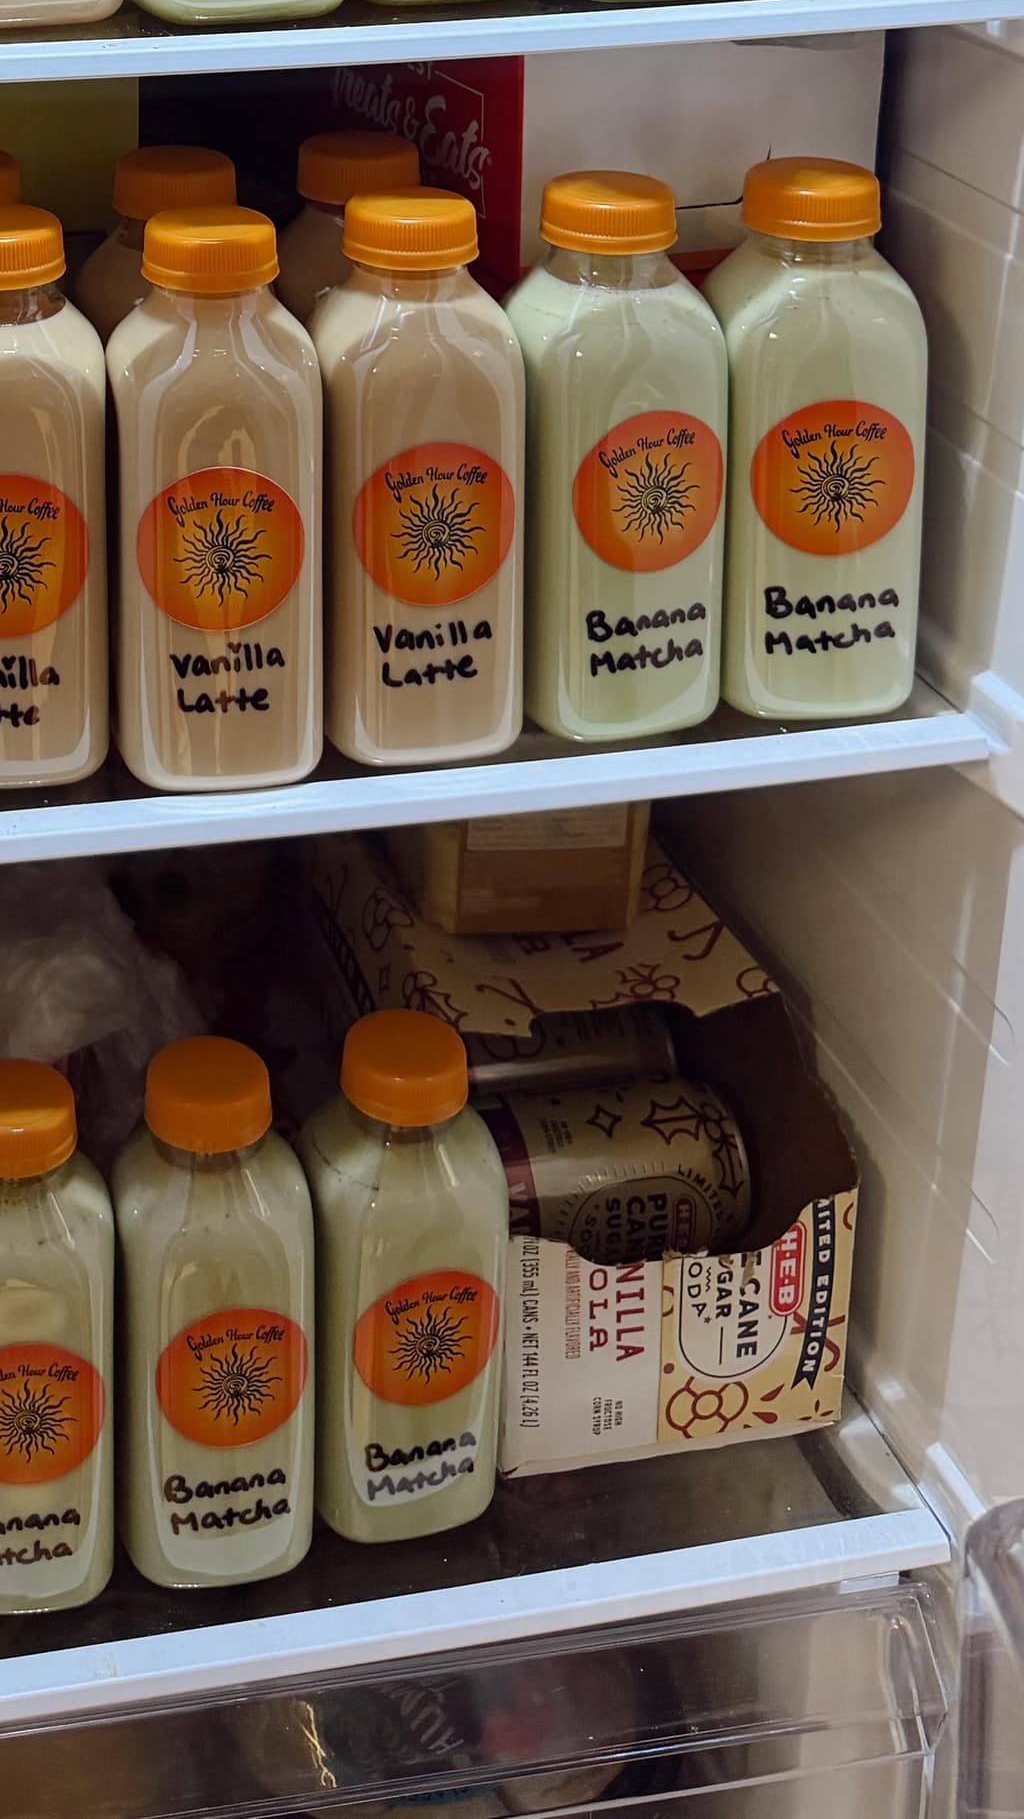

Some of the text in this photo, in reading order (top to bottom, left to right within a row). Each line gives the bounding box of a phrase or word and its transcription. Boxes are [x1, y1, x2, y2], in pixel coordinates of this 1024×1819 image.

[598, 429, 694, 477] Golden Hour Coffee
[782, 421, 886, 459] Golden Hour Coffee
[386, 464, 488, 502] Golden Hour Coffee
[28, 498, 60, 520] Coffee
[167, 490, 275, 527] Golden Hour Coffee
[764, 586, 899, 619] Banana
[374, 620, 492, 654] Vanilla
[586, 602, 706, 642] Banana
[765, 619, 894, 655] Matcha
[382, 652, 478, 688] Latte
[590, 639, 703, 676] Matcha
[177, 687, 270, 713] Latte
[520, 1258, 540, 1278] (355
[802, 1198, 835, 1373] MITED EDITION
[686, 1262, 707, 1318] ODA
[522, 1300, 538, 1324] CANS
[588, 1268, 608, 1352] OLA
[615, 1262, 646, 1362] NILLA
[736, 1277, 761, 1359] CANE
[522, 1333, 538, 1349] NET
[522, 1352, 538, 1367] 144
[365, 1430, 476, 1472] Banana
[163, 1468, 286, 1505] Banana
[367, 1457, 475, 1502] Matcha
[169, 1499, 292, 1536] Matcha
